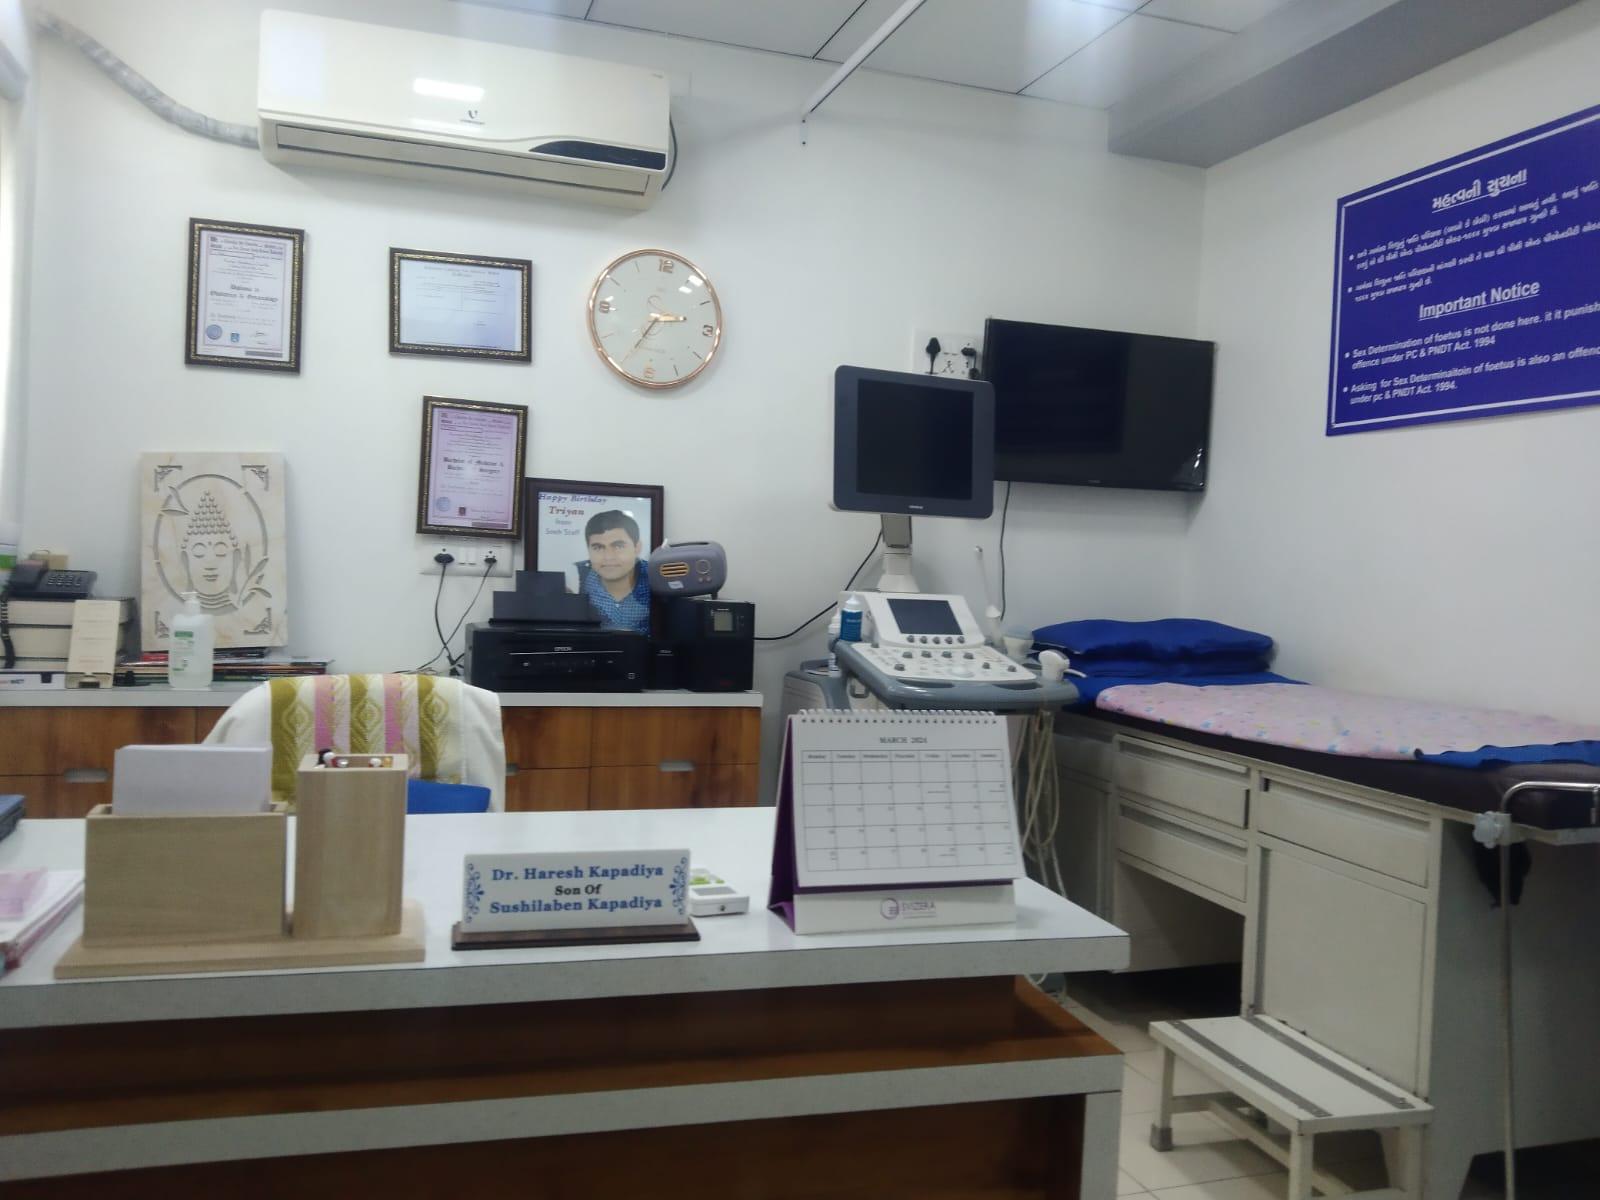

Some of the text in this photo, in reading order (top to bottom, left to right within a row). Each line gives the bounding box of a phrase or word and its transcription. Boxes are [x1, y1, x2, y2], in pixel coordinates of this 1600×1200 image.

[659, 258, 674, 274] 12
[1419, 281, 1540, 319] Important Notice
[702, 324, 714, 337] 3
[1352, 348, 1367, 359] Sex
[1424, 334, 1434, 344] of
[1434, 329, 1462, 343] foetus
[1463, 327, 1473, 337] is
[1474, 324, 1490, 335] not
[1491, 320, 1515, 331] done
[1351, 358, 1380, 370] offence
[1381, 353, 1404, 365] under
[1405, 349, 1418, 360] PC
[1419, 347, 1426, 358] &
[1427, 342, 1453, 356] PNDT
[1474, 335, 1496, 348] 1994
[1350, 382, 1377, 393] Asking
[1380, 378, 1392, 388] for
[1393, 376, 1409, 387] Sex
[1473, 362, 1484, 374] of
[1484, 358, 1515, 372] foetus
[1516, 356, 1527, 367] is
[1528, 353, 1550, 366] also
[1551, 350, 1566, 361] an
[1350, 394, 1372, 405] under
[1373, 392, 1383, 403] pc
[1384, 390, 1391, 400] &
[1392, 386, 1416, 399] PNDT
[879, 736, 908, 745] MARCH
[491, 863, 664, 881] Dr. Haresh Kapadiya
[554, 883, 603, 896] Son Of
[489, 896, 663, 914] Sushilaben Kapadiya
